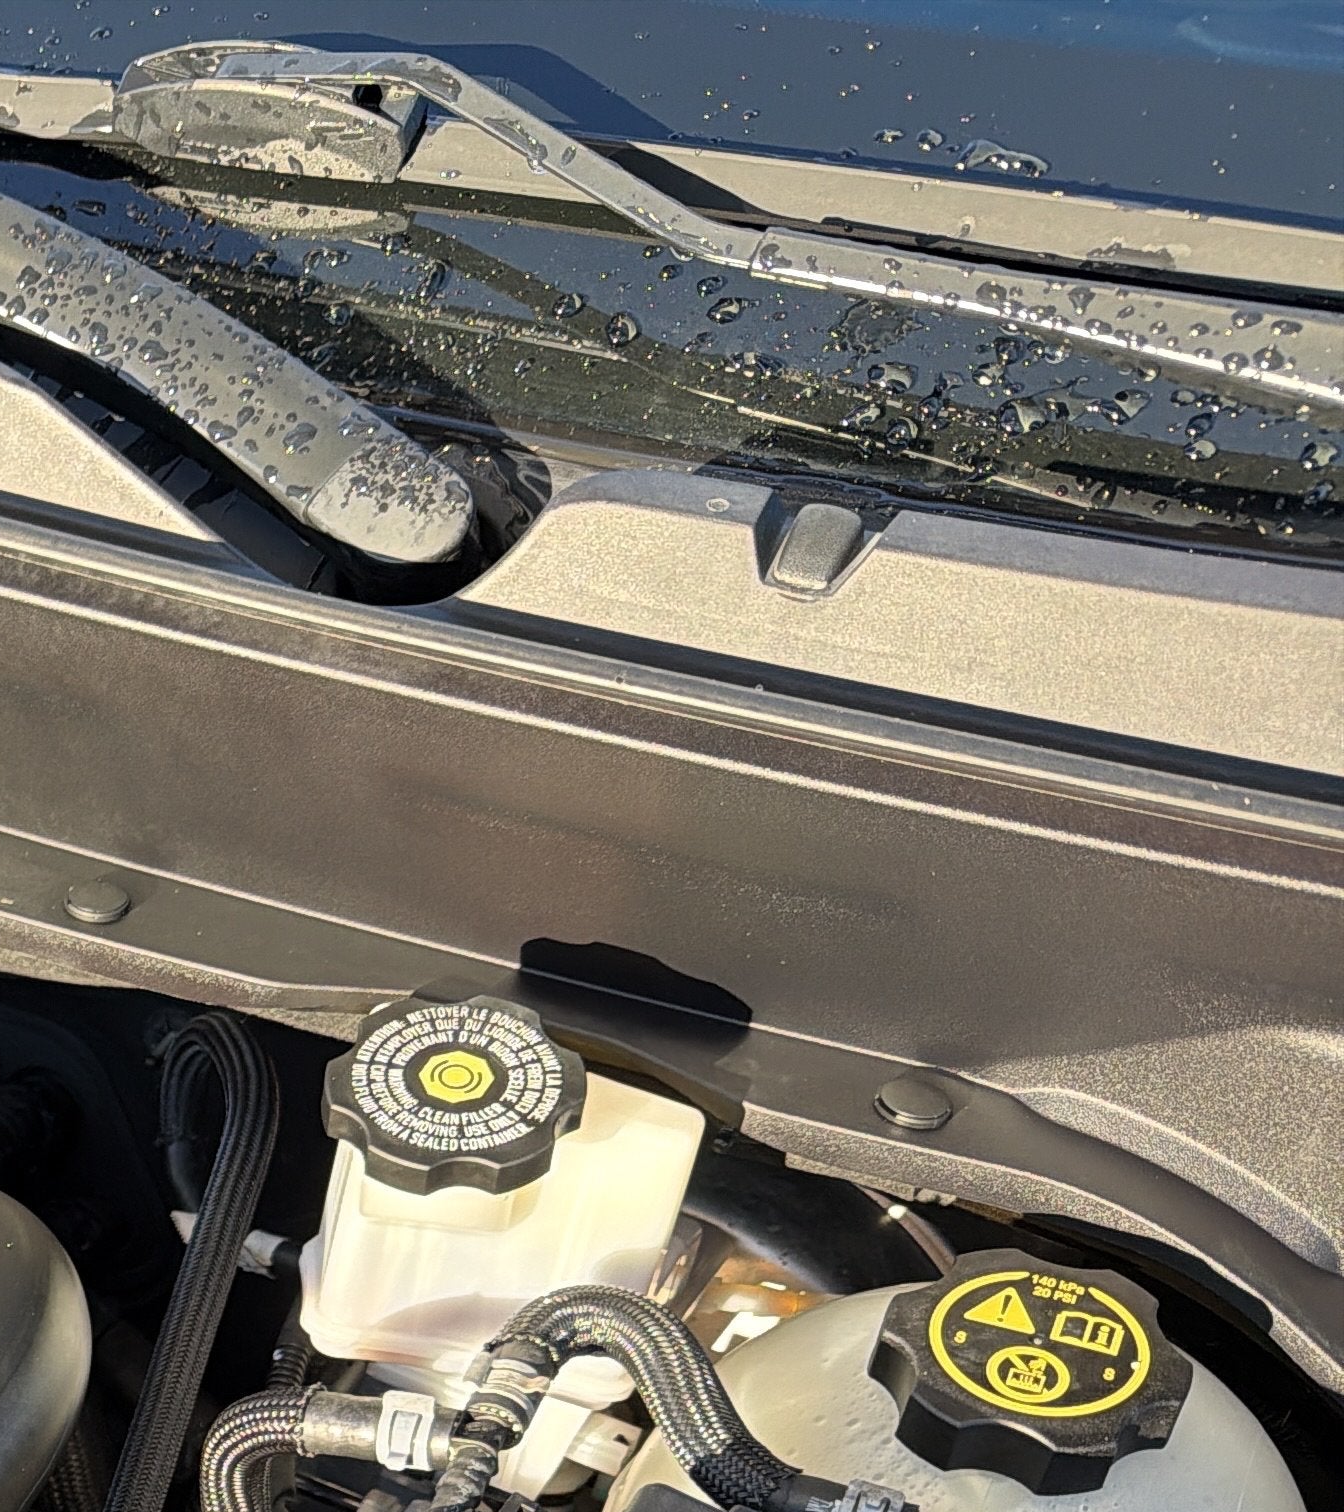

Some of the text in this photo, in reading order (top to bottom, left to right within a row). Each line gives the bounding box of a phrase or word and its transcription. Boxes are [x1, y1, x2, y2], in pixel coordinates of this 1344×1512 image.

[406, 1005, 468, 1025] NETTOYER
[435, 1018, 459, 1030] QUE
[472, 1008, 488, 1020] LE
[464, 1019, 480, 1031] DU
[491, 1012, 543, 1046] BOUCHON
[484, 1024, 526, 1053] LIQUIDE
[399, 1031, 453, 1066] PROVENANT
[488, 1041, 519, 1069] BIDON
[518, 1048, 533, 1063] DE
[533, 1040, 561, 1073] AVANT
[370, 1065, 385, 1083] CAP
[525, 1062, 543, 1084] FREIN
[546, 1074, 562, 1087] LA
[370, 1081, 402, 1115] BEFORE
[352, 1088, 375, 1114] FLUID
[369, 1112, 399, 1136] FROM
[398, 1129, 410, 1141] A
[409, 1136, 459, 1151] SEALED
[419, 1107, 461, 1125] CLEAN
[462, 1104, 507, 1124] FILLER
[491, 1113, 521, 1134] ONLY
[465, 1125, 488, 1138] USE
[1031, 1274, 1086, 1296] 140 kPa
[1033, 1285, 1077, 1305] 20 PSI
